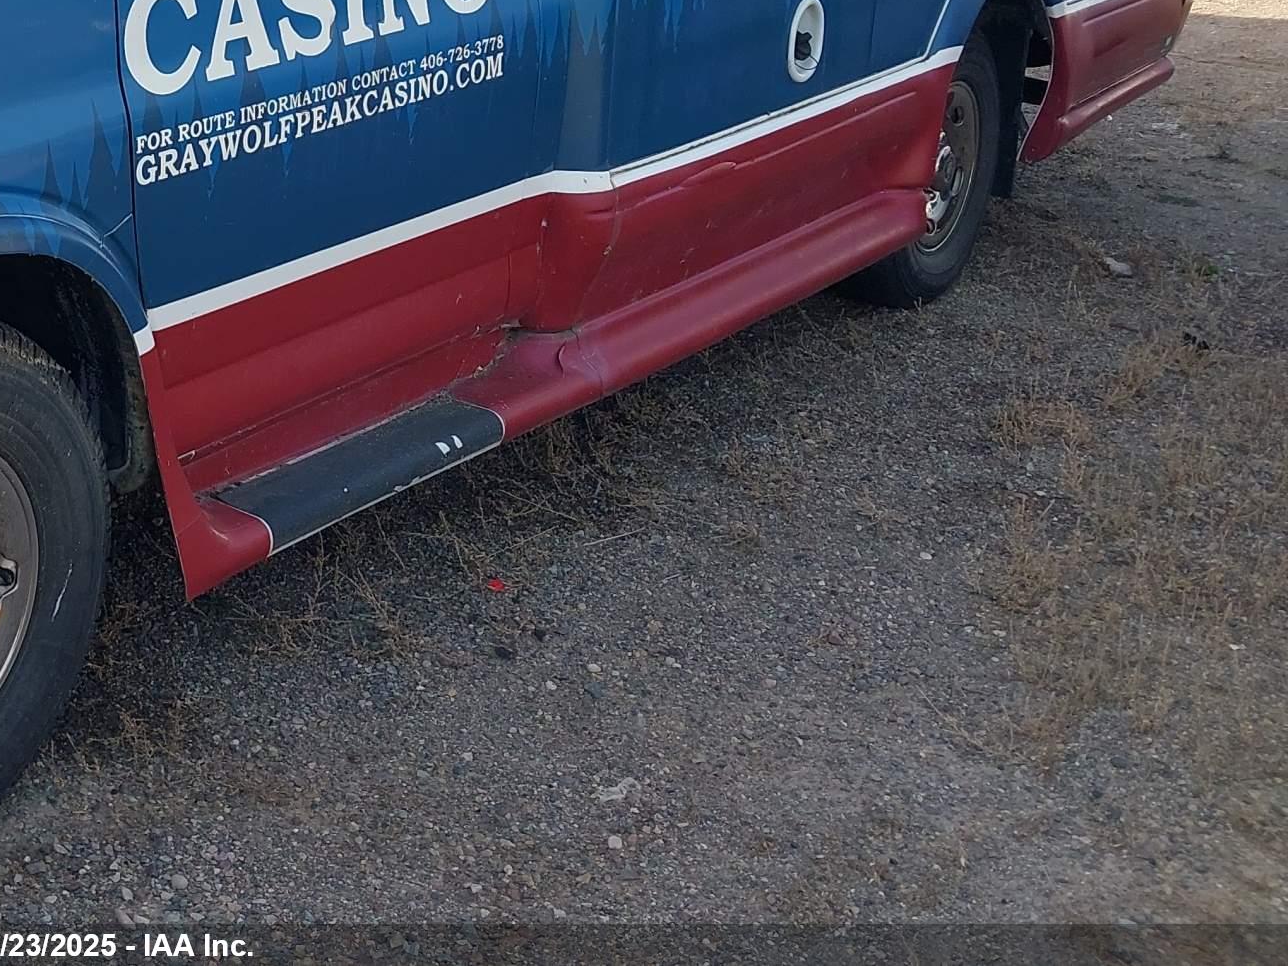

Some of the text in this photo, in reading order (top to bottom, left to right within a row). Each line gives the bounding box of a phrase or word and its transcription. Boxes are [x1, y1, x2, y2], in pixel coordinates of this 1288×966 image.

[136, 34, 504, 154] FOR ROUTE INFORMATION CONTACT 406-726-3778
[136, 52, 503, 186] GRAYWOLFPEAKCASINO.COM
